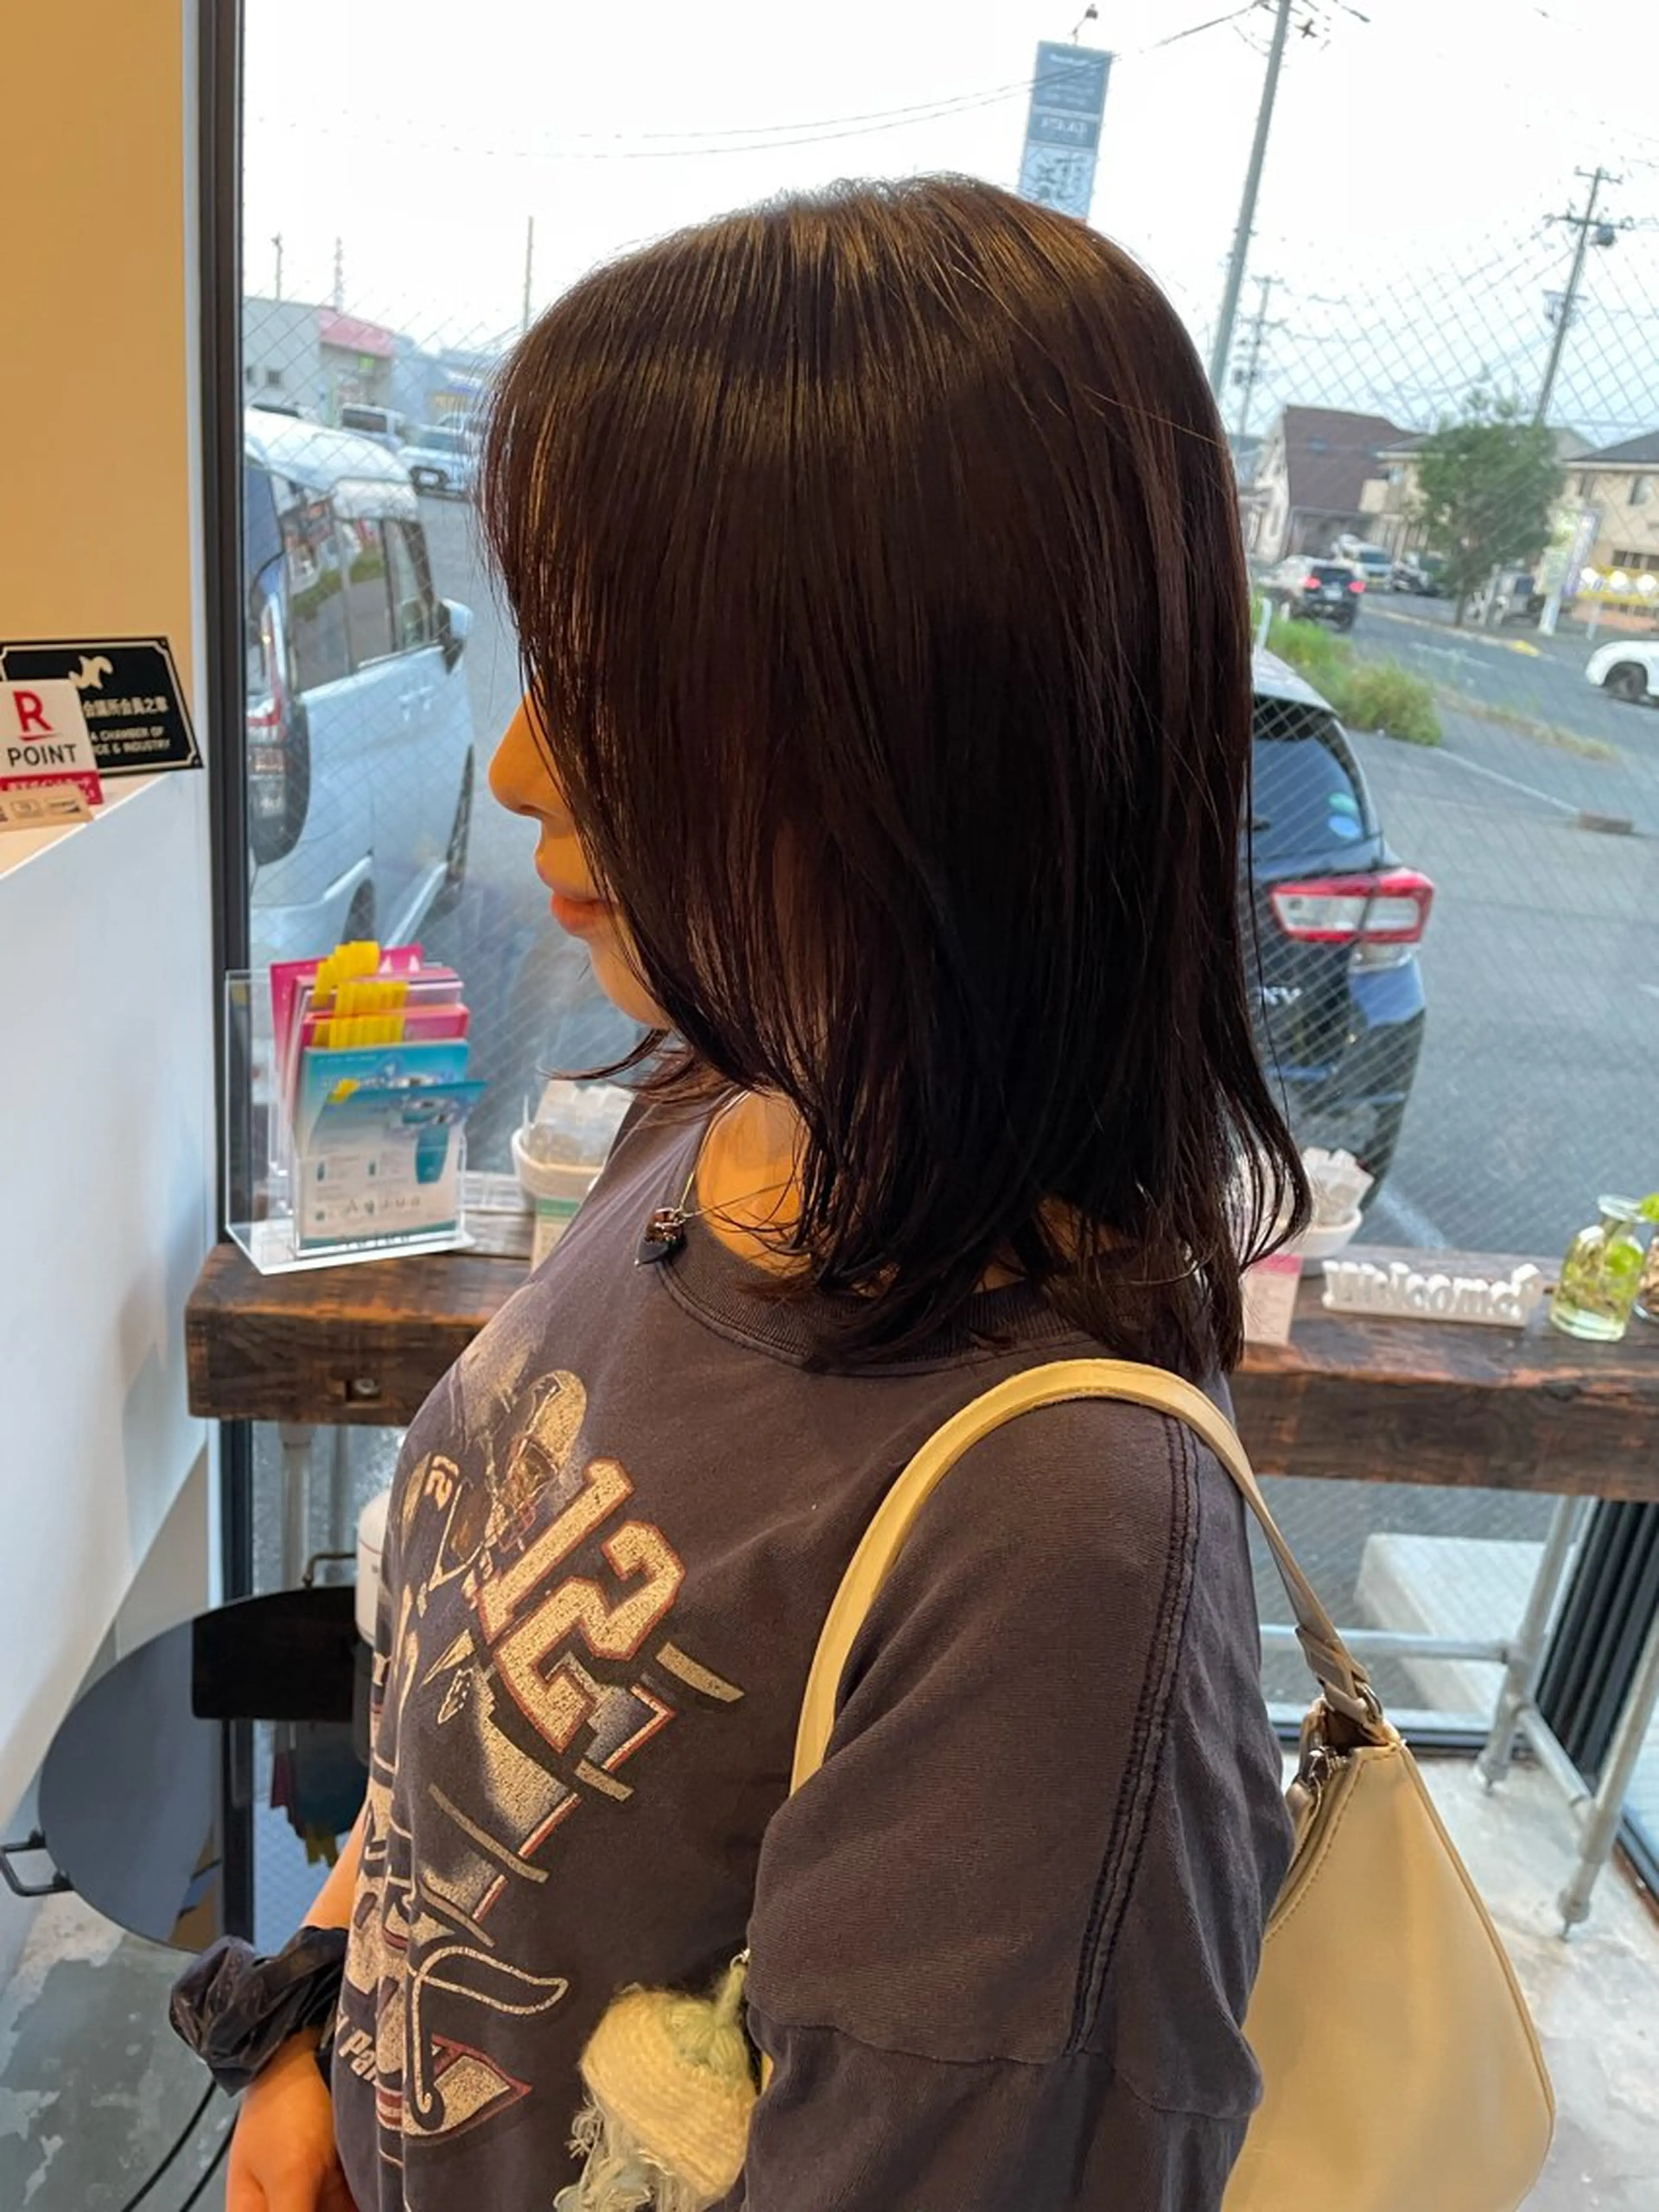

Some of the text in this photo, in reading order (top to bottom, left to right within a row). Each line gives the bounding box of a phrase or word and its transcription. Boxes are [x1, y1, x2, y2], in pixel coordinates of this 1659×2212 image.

[13, 690, 53, 731] R
[7, 744, 76, 768] POINT
[476, 1457, 686, 1753] 12
